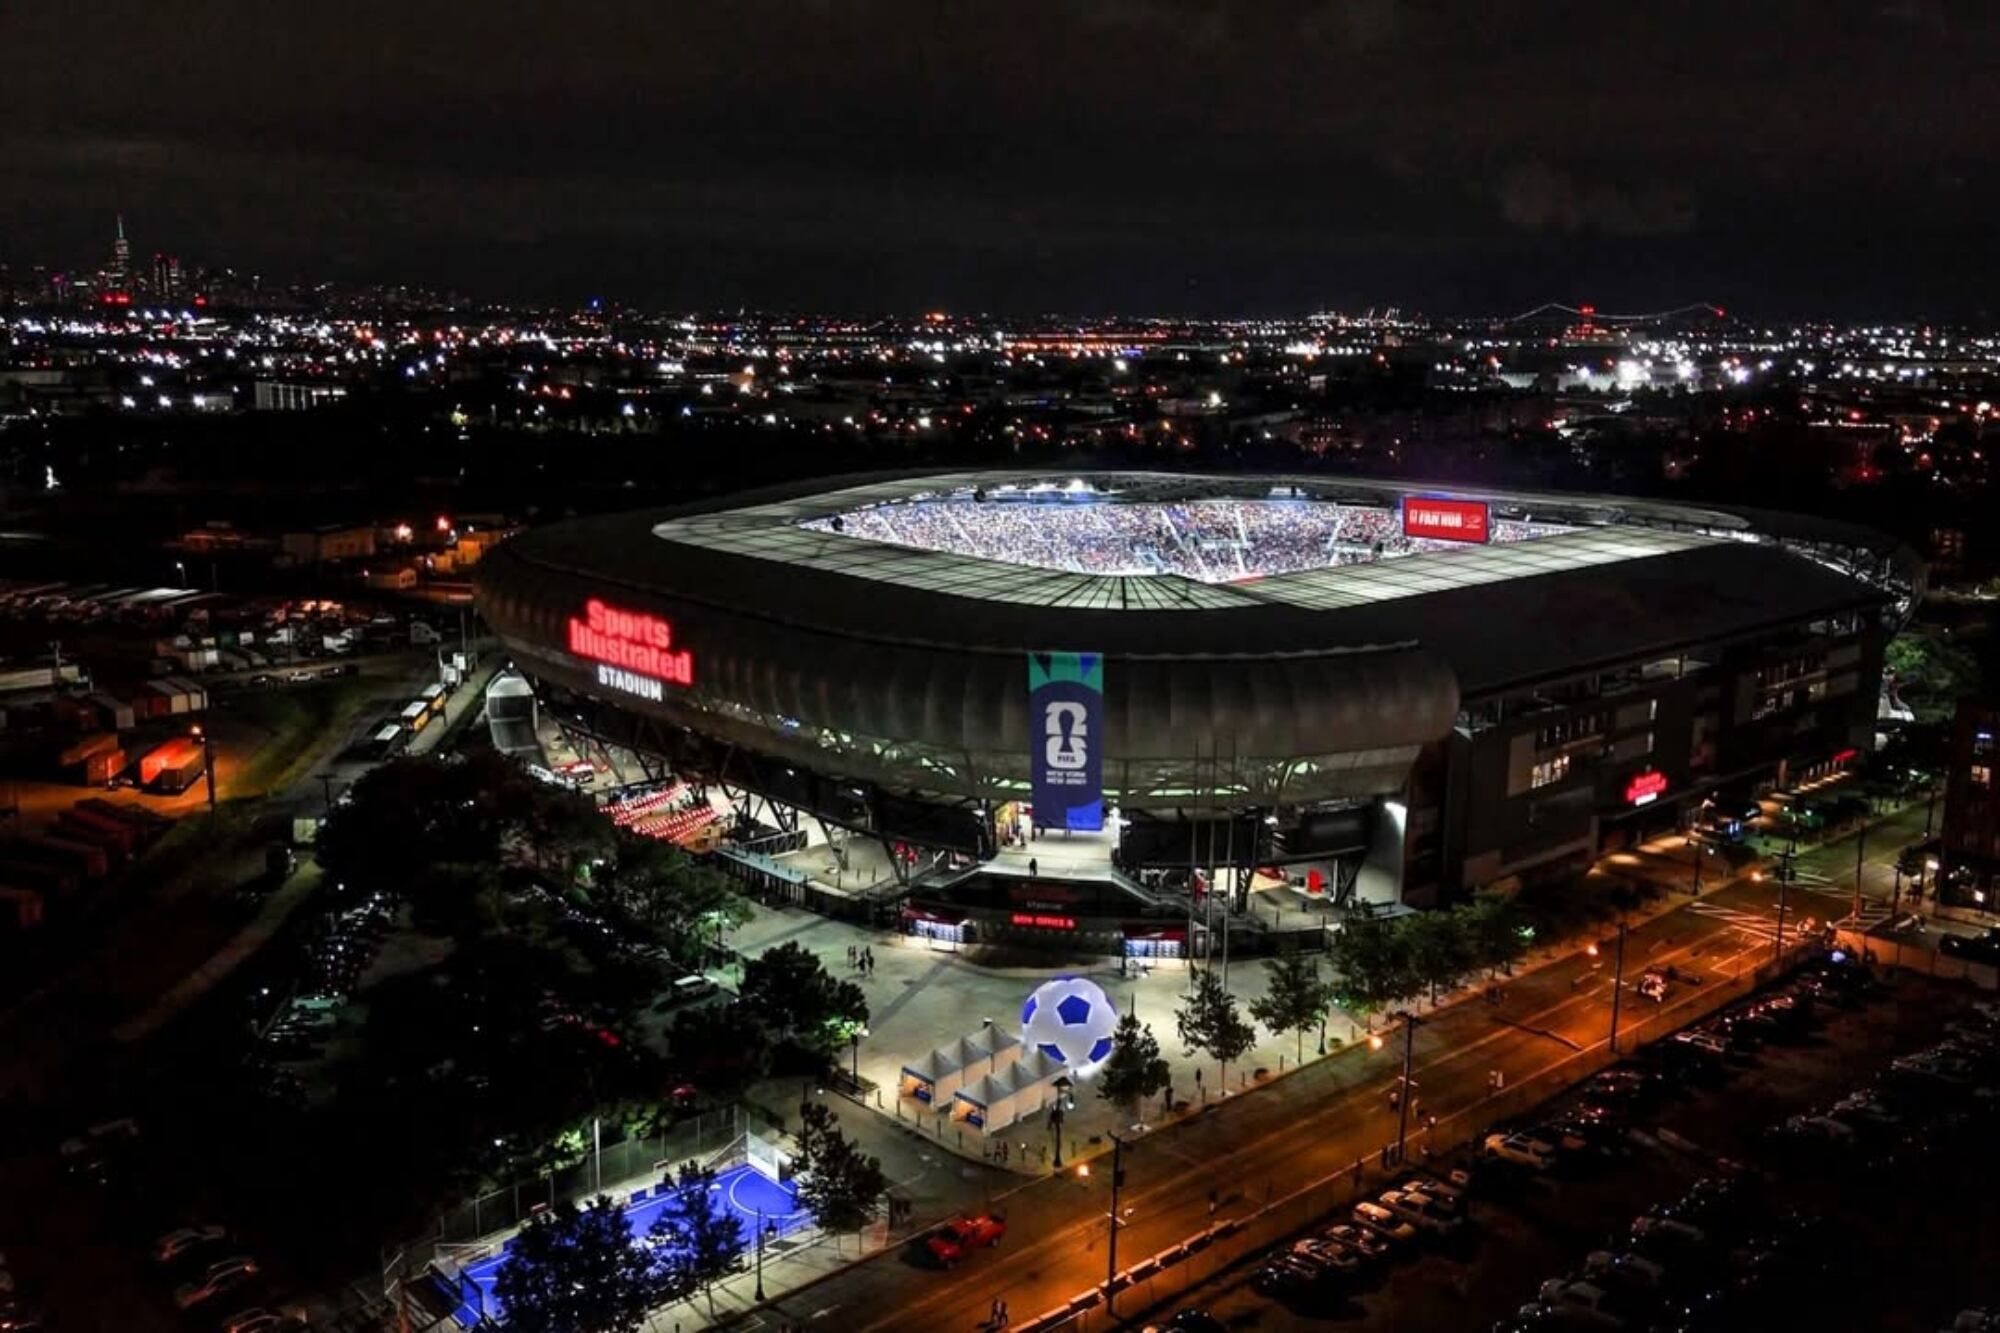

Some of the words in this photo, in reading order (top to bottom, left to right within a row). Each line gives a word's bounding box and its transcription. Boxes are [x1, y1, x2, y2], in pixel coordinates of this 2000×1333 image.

[587, 599, 670, 648] Sports
[570, 618, 692, 685] Illustrated
[598, 664, 663, 702] STADIUM
[1057, 755, 1077, 763] FIFA
